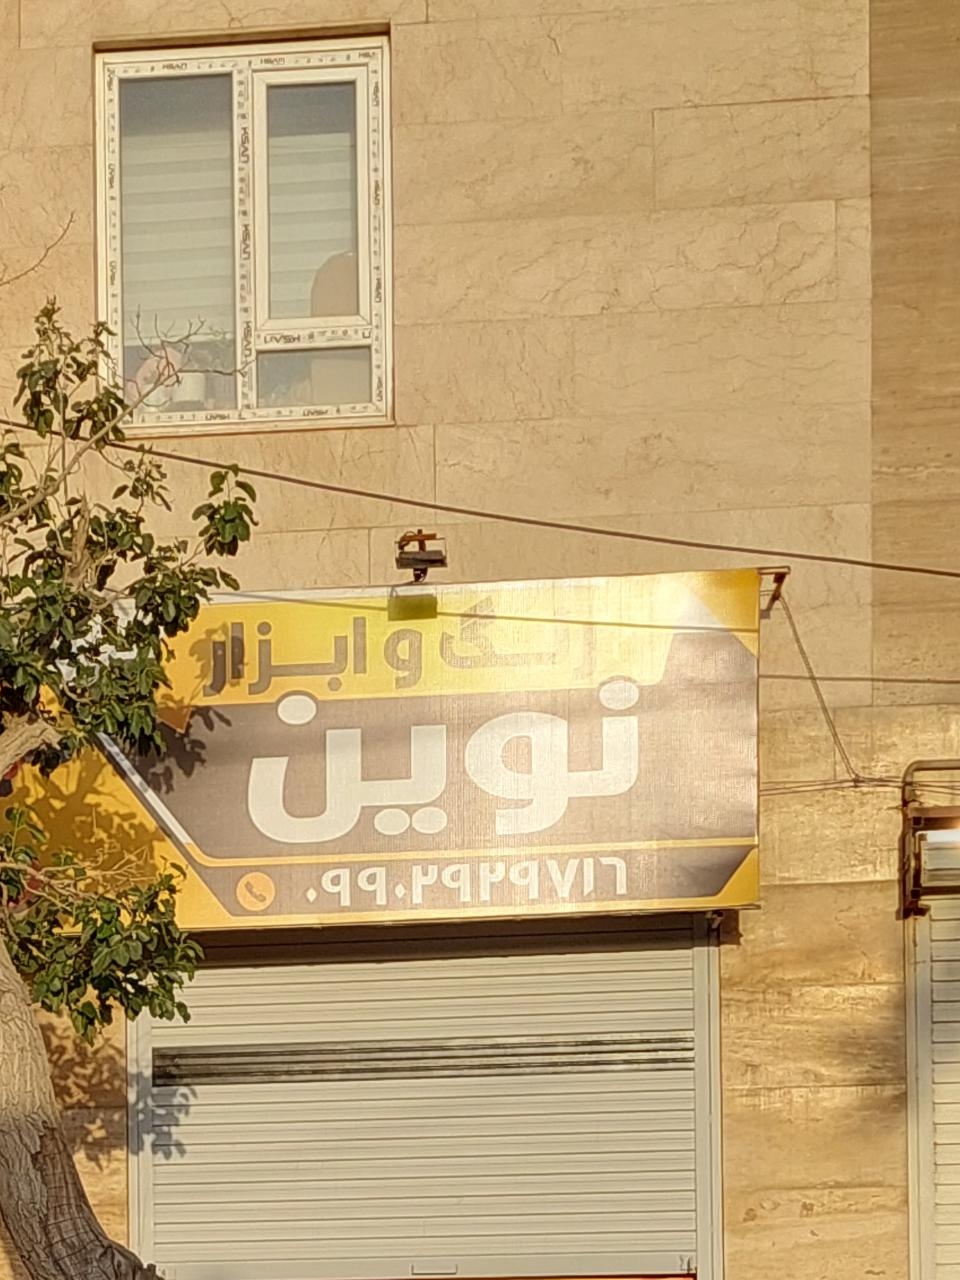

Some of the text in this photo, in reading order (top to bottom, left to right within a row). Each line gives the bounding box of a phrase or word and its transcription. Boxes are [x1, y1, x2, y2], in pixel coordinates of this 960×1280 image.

[202, 614, 368, 698] ابزار
[384, 629, 424, 688] و
[246, 676, 640, 844] نوین
